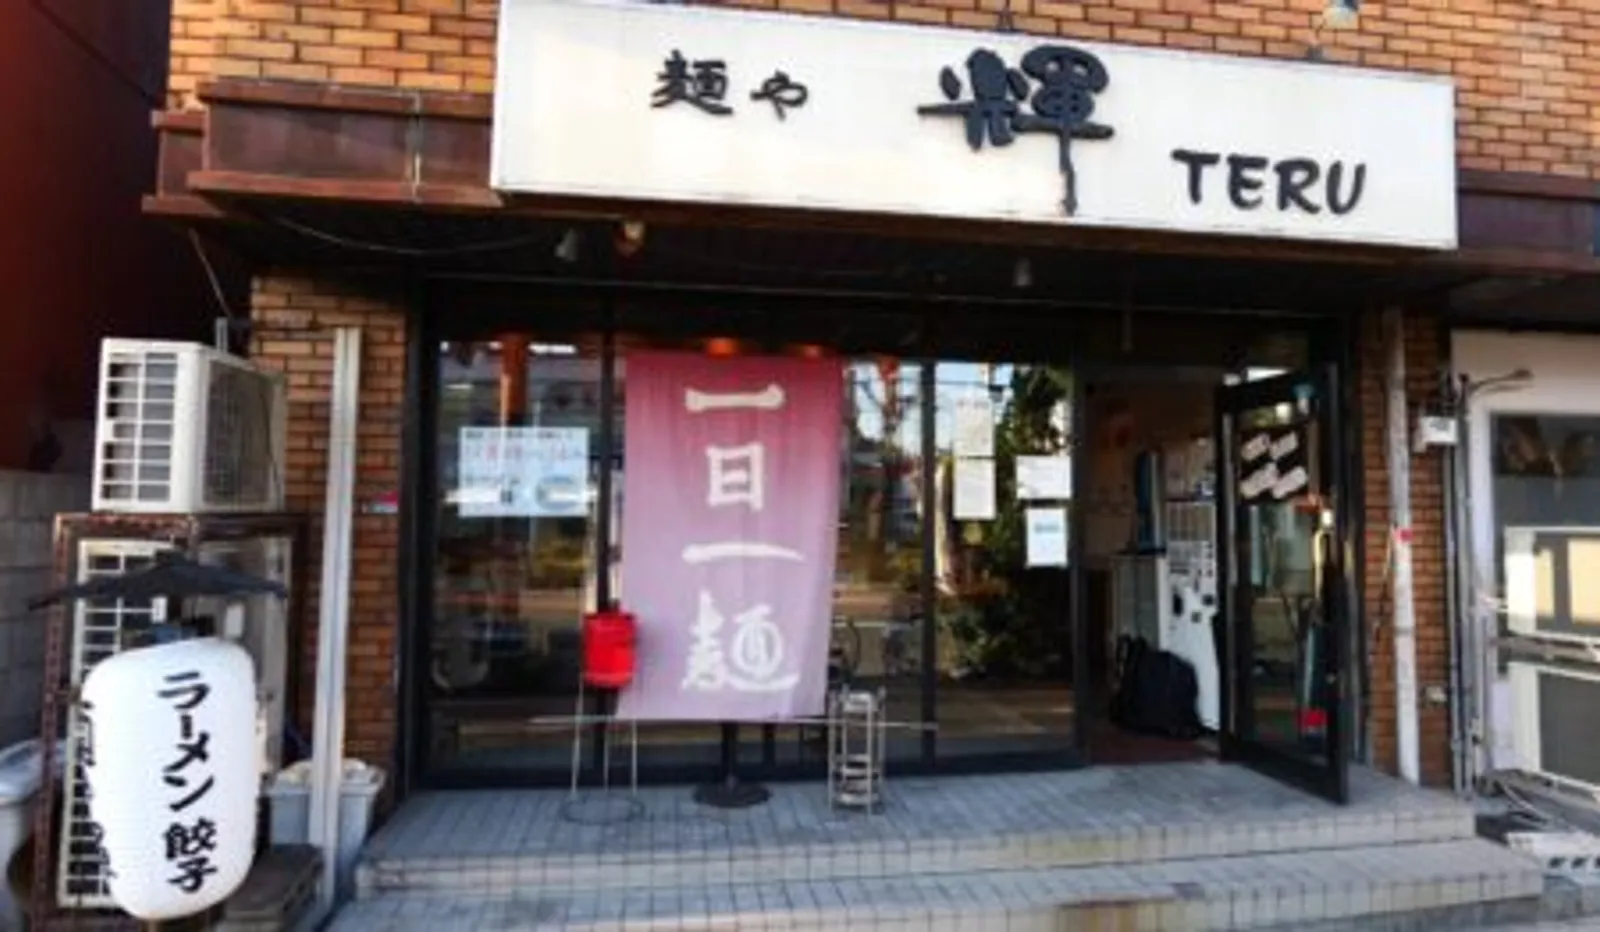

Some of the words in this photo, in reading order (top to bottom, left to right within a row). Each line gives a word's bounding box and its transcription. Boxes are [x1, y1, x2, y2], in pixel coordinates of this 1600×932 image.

[650, 48, 808, 120] 麺や
[917, 45, 1114, 215] 輝
[1171, 148, 1367, 216] TERU
[681, 383, 803, 692] 一日一麺
